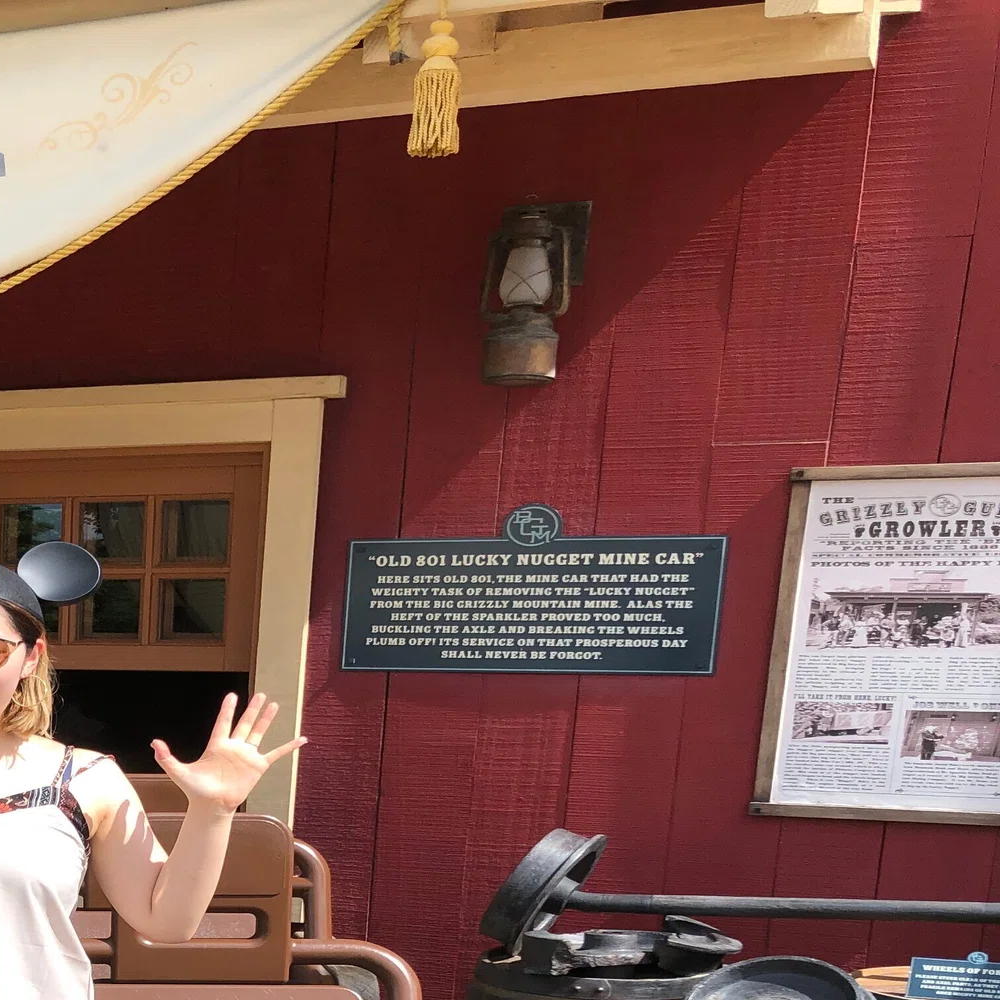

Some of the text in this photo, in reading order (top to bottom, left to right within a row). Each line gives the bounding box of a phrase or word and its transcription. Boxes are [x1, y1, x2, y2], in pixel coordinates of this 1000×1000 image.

[819, 500, 926, 527] GRIZZLY
[869, 520, 986, 538] GROWLER
[416, 555, 446, 566] 801
[451, 554, 512, 566] LUCKY
[516, 554, 594, 566] NUGGET
[598, 553, 650, 564] MINE
[378, 576, 410, 584] HERE
[412, 576, 440, 584] SITS
[496, 575, 522, 583] THE
[562, 574, 588, 582] CAR
[591, 574, 627, 582] THAT
[630, 574, 659, 582] HAD
[662, 574, 689, 582] THE
[372, 588, 428, 596] WEIGHTY
[485, 588, 552, 596] REMOVING
[457, 600, 509, 608] GRIZZLY
[512, 600, 580, 608] MOUNTAIN
[584, 600, 622, 608] MINE.
[627, 600, 662, 608] ALAS
[666, 600, 693, 608] THE
[472, 613, 538, 621] SPARKLER
[372, 626, 431, 634] BUCKLING
[434, 626, 458, 634] THE
[462, 626, 496, 634] AXLE
[528, 626, 595, 634] BREAKING
[598, 626, 624, 634] THE
[627, 626, 684, 634] WHEELS
[439, 638, 459, 646] ITS
[462, 638, 515, 646] SERVICE
[517, 638, 534, 646] ON
[575, 639, 658, 647] PROSPEROUS
[441, 650, 482, 658] SHALL
[485, 651, 527, 659] NEVER
[922, 964, 965, 974] WHEELS
